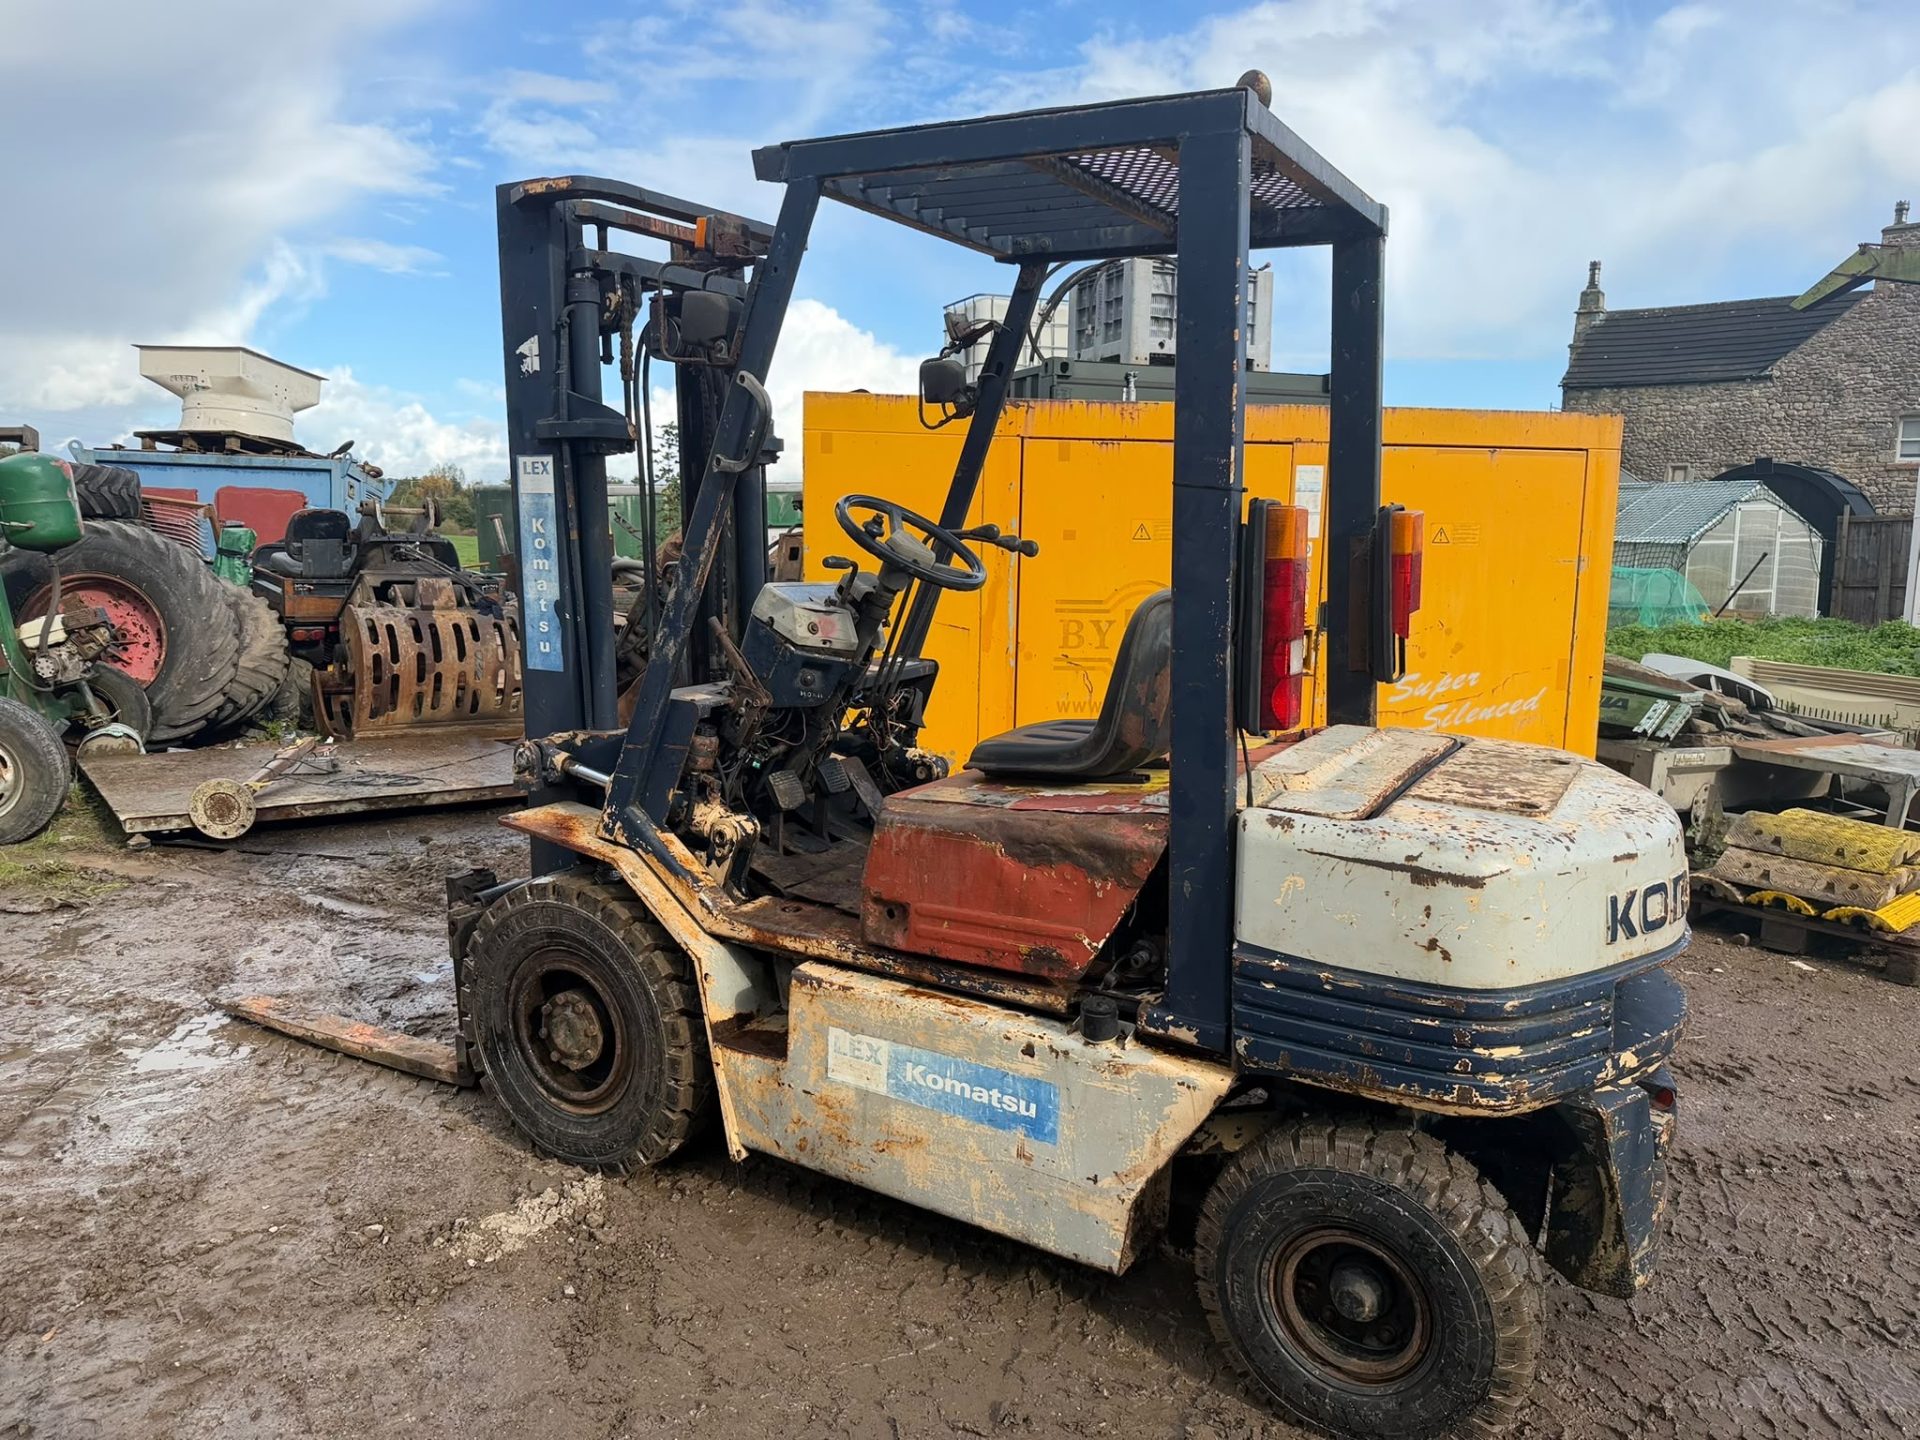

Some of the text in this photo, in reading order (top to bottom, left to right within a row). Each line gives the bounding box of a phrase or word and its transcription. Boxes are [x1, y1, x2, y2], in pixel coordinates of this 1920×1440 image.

[523, 461, 550, 475] LEX
[531, 517, 551, 653] Komatsu
[1388, 671, 1480, 703] Super
[1420, 686, 1548, 731] Silenced
[833, 1034, 1037, 1119] LEX Komatsu
